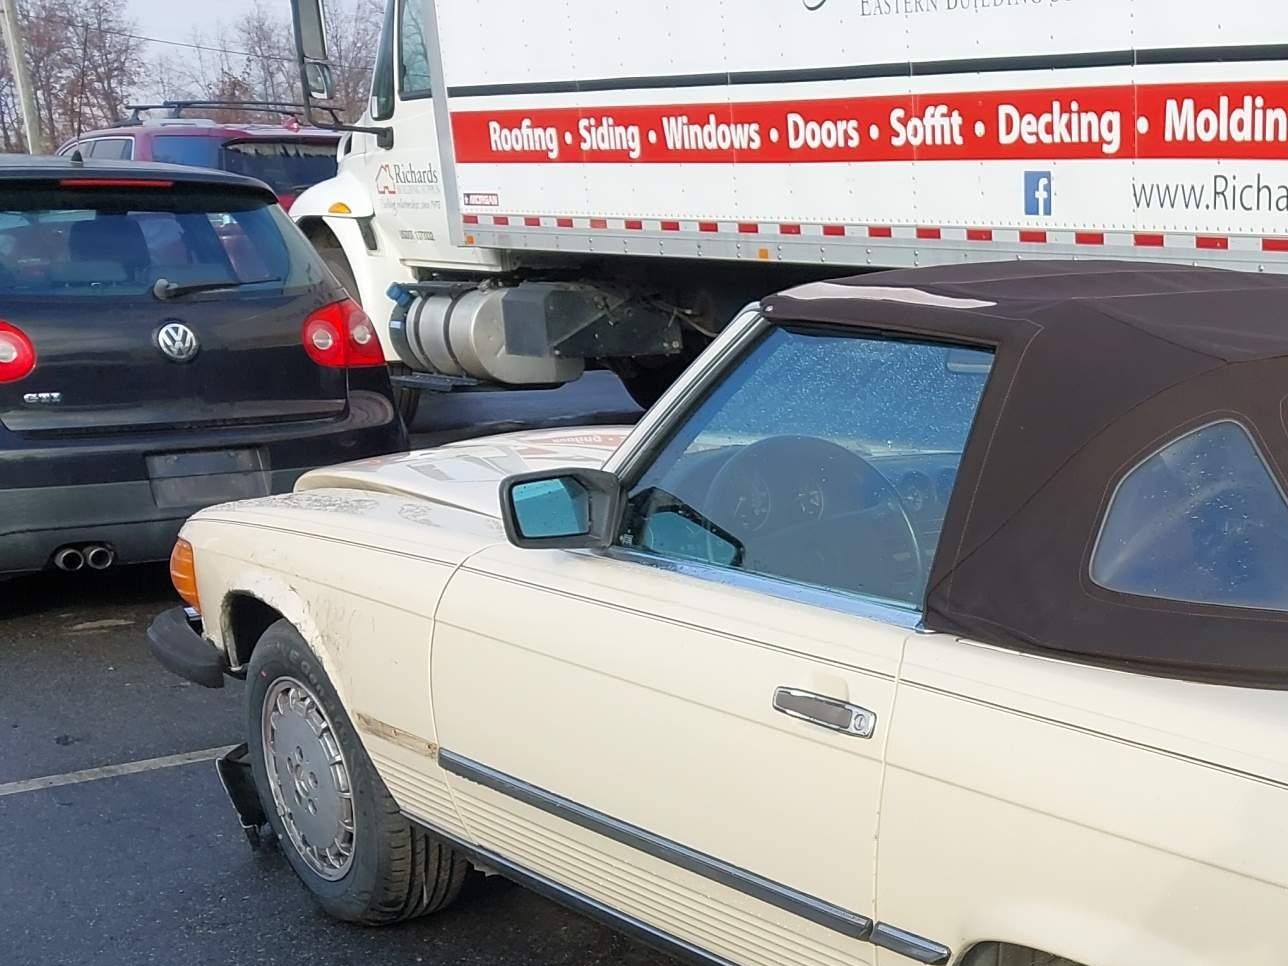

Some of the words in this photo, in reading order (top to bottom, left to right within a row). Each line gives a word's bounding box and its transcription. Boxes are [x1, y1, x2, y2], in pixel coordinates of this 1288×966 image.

[488, 118, 559, 160] Roofing
[578, 116, 641, 159] Siding
[662, 113, 761, 151] Windows
[786, 112, 860, 150] Doors
[889, 104, 964, 147] Soffit
[996, 100, 1121, 154] Decking
[394, 162, 439, 184] Richards
[23, 392, 61, 403] GTI
